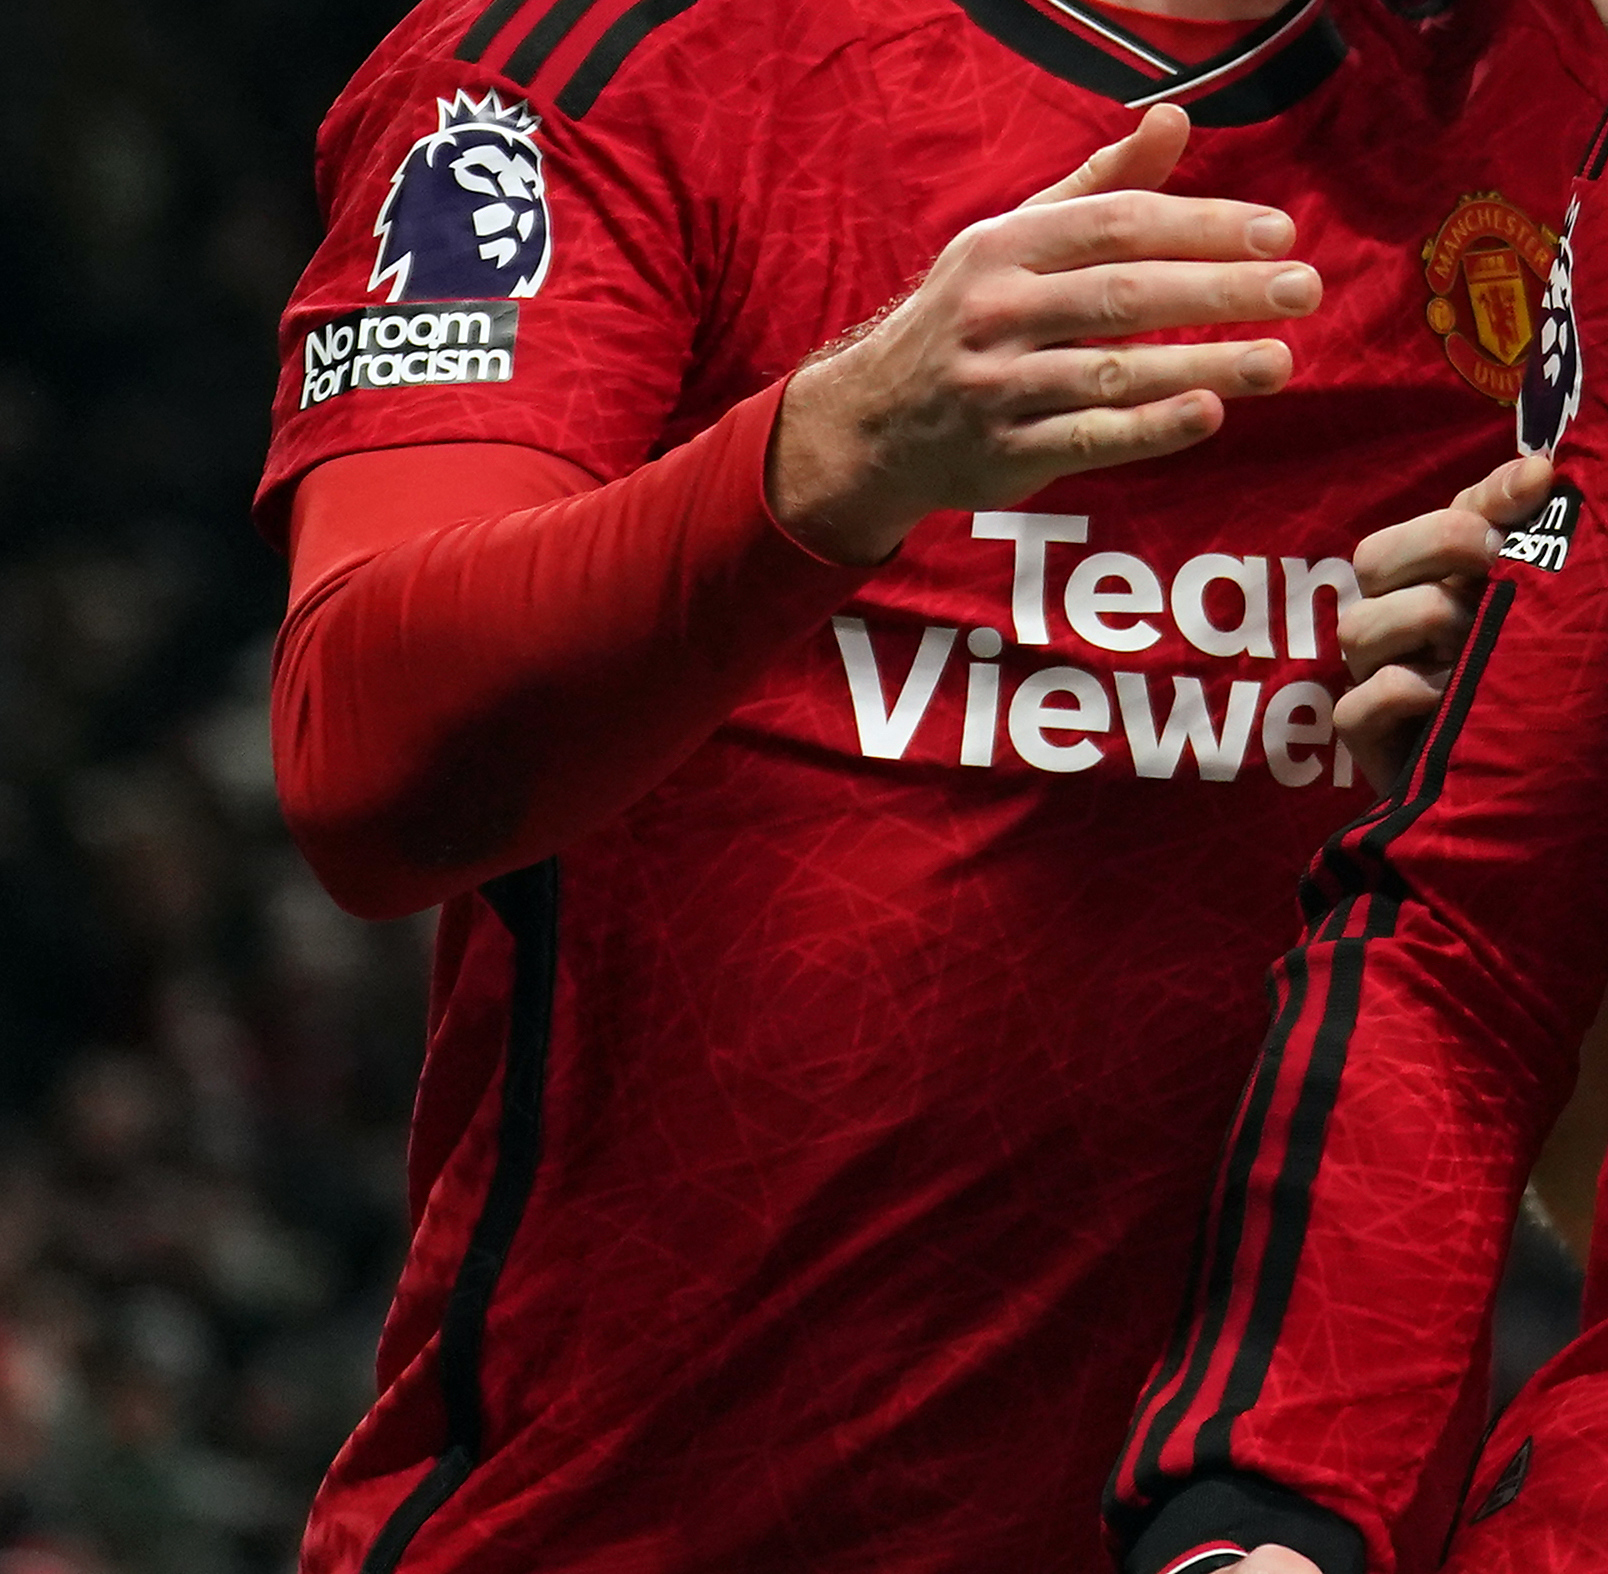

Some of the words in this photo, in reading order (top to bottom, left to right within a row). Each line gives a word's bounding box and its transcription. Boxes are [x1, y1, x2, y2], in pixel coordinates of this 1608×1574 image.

[1434, 207, 1549, 280] MANCHESTER
[304, 323, 355, 375] No
[356, 311, 491, 350] room
[300, 362, 351, 411] for
[350, 347, 512, 387] racism
